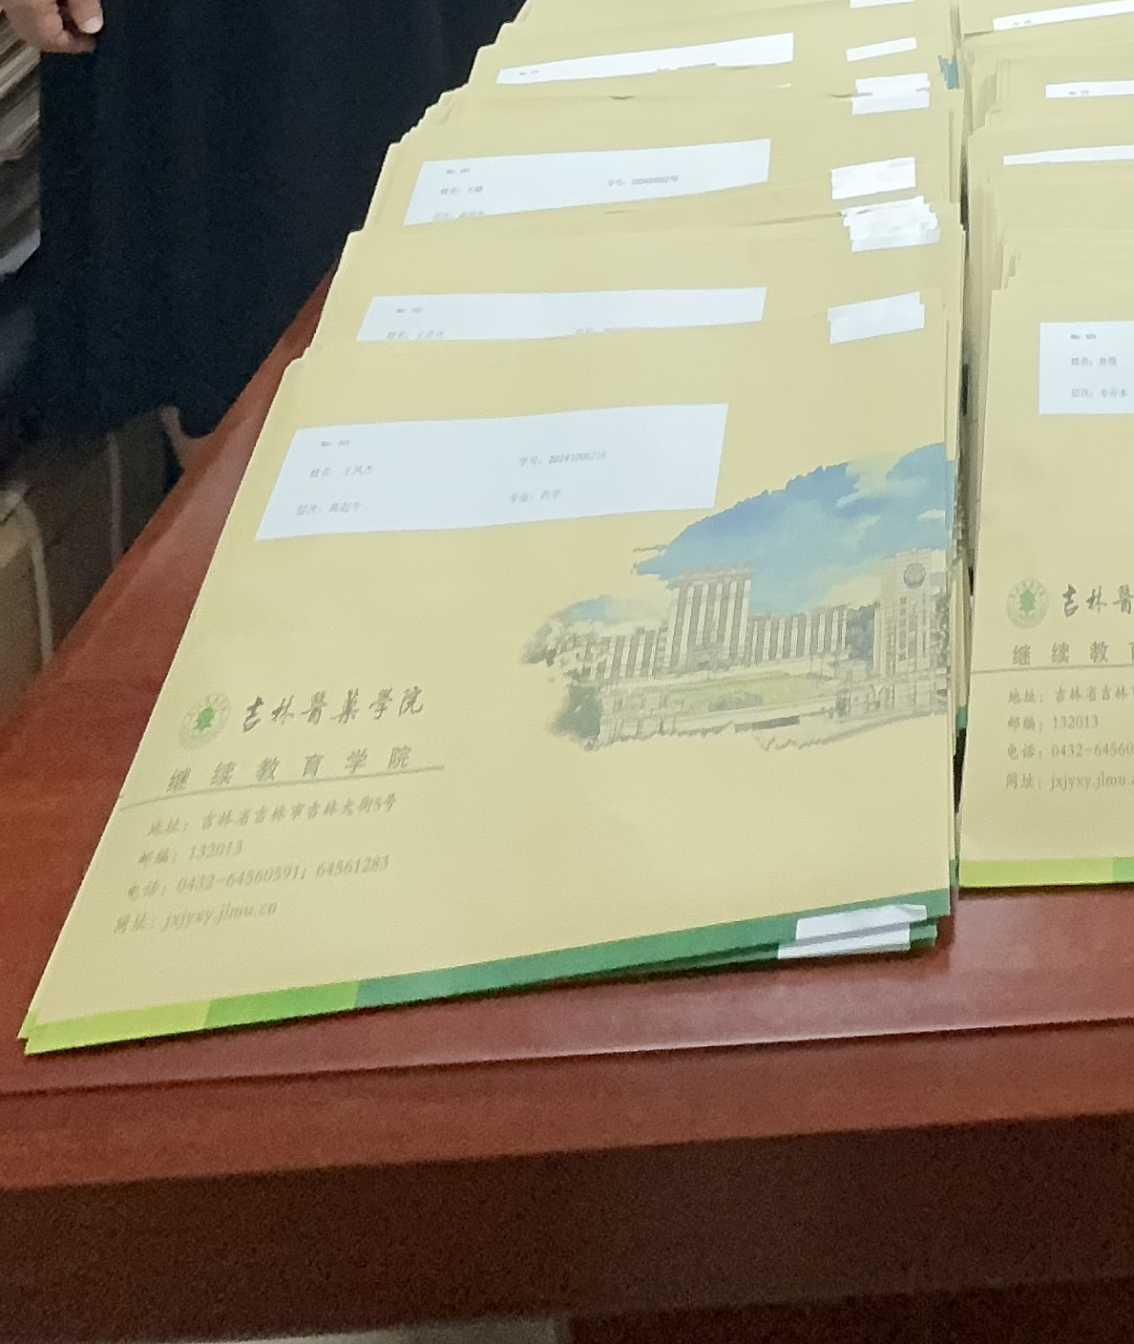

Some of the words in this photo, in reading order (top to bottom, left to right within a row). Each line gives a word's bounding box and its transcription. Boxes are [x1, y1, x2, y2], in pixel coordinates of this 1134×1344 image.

[166, 743, 412, 792] 继续教育学院
